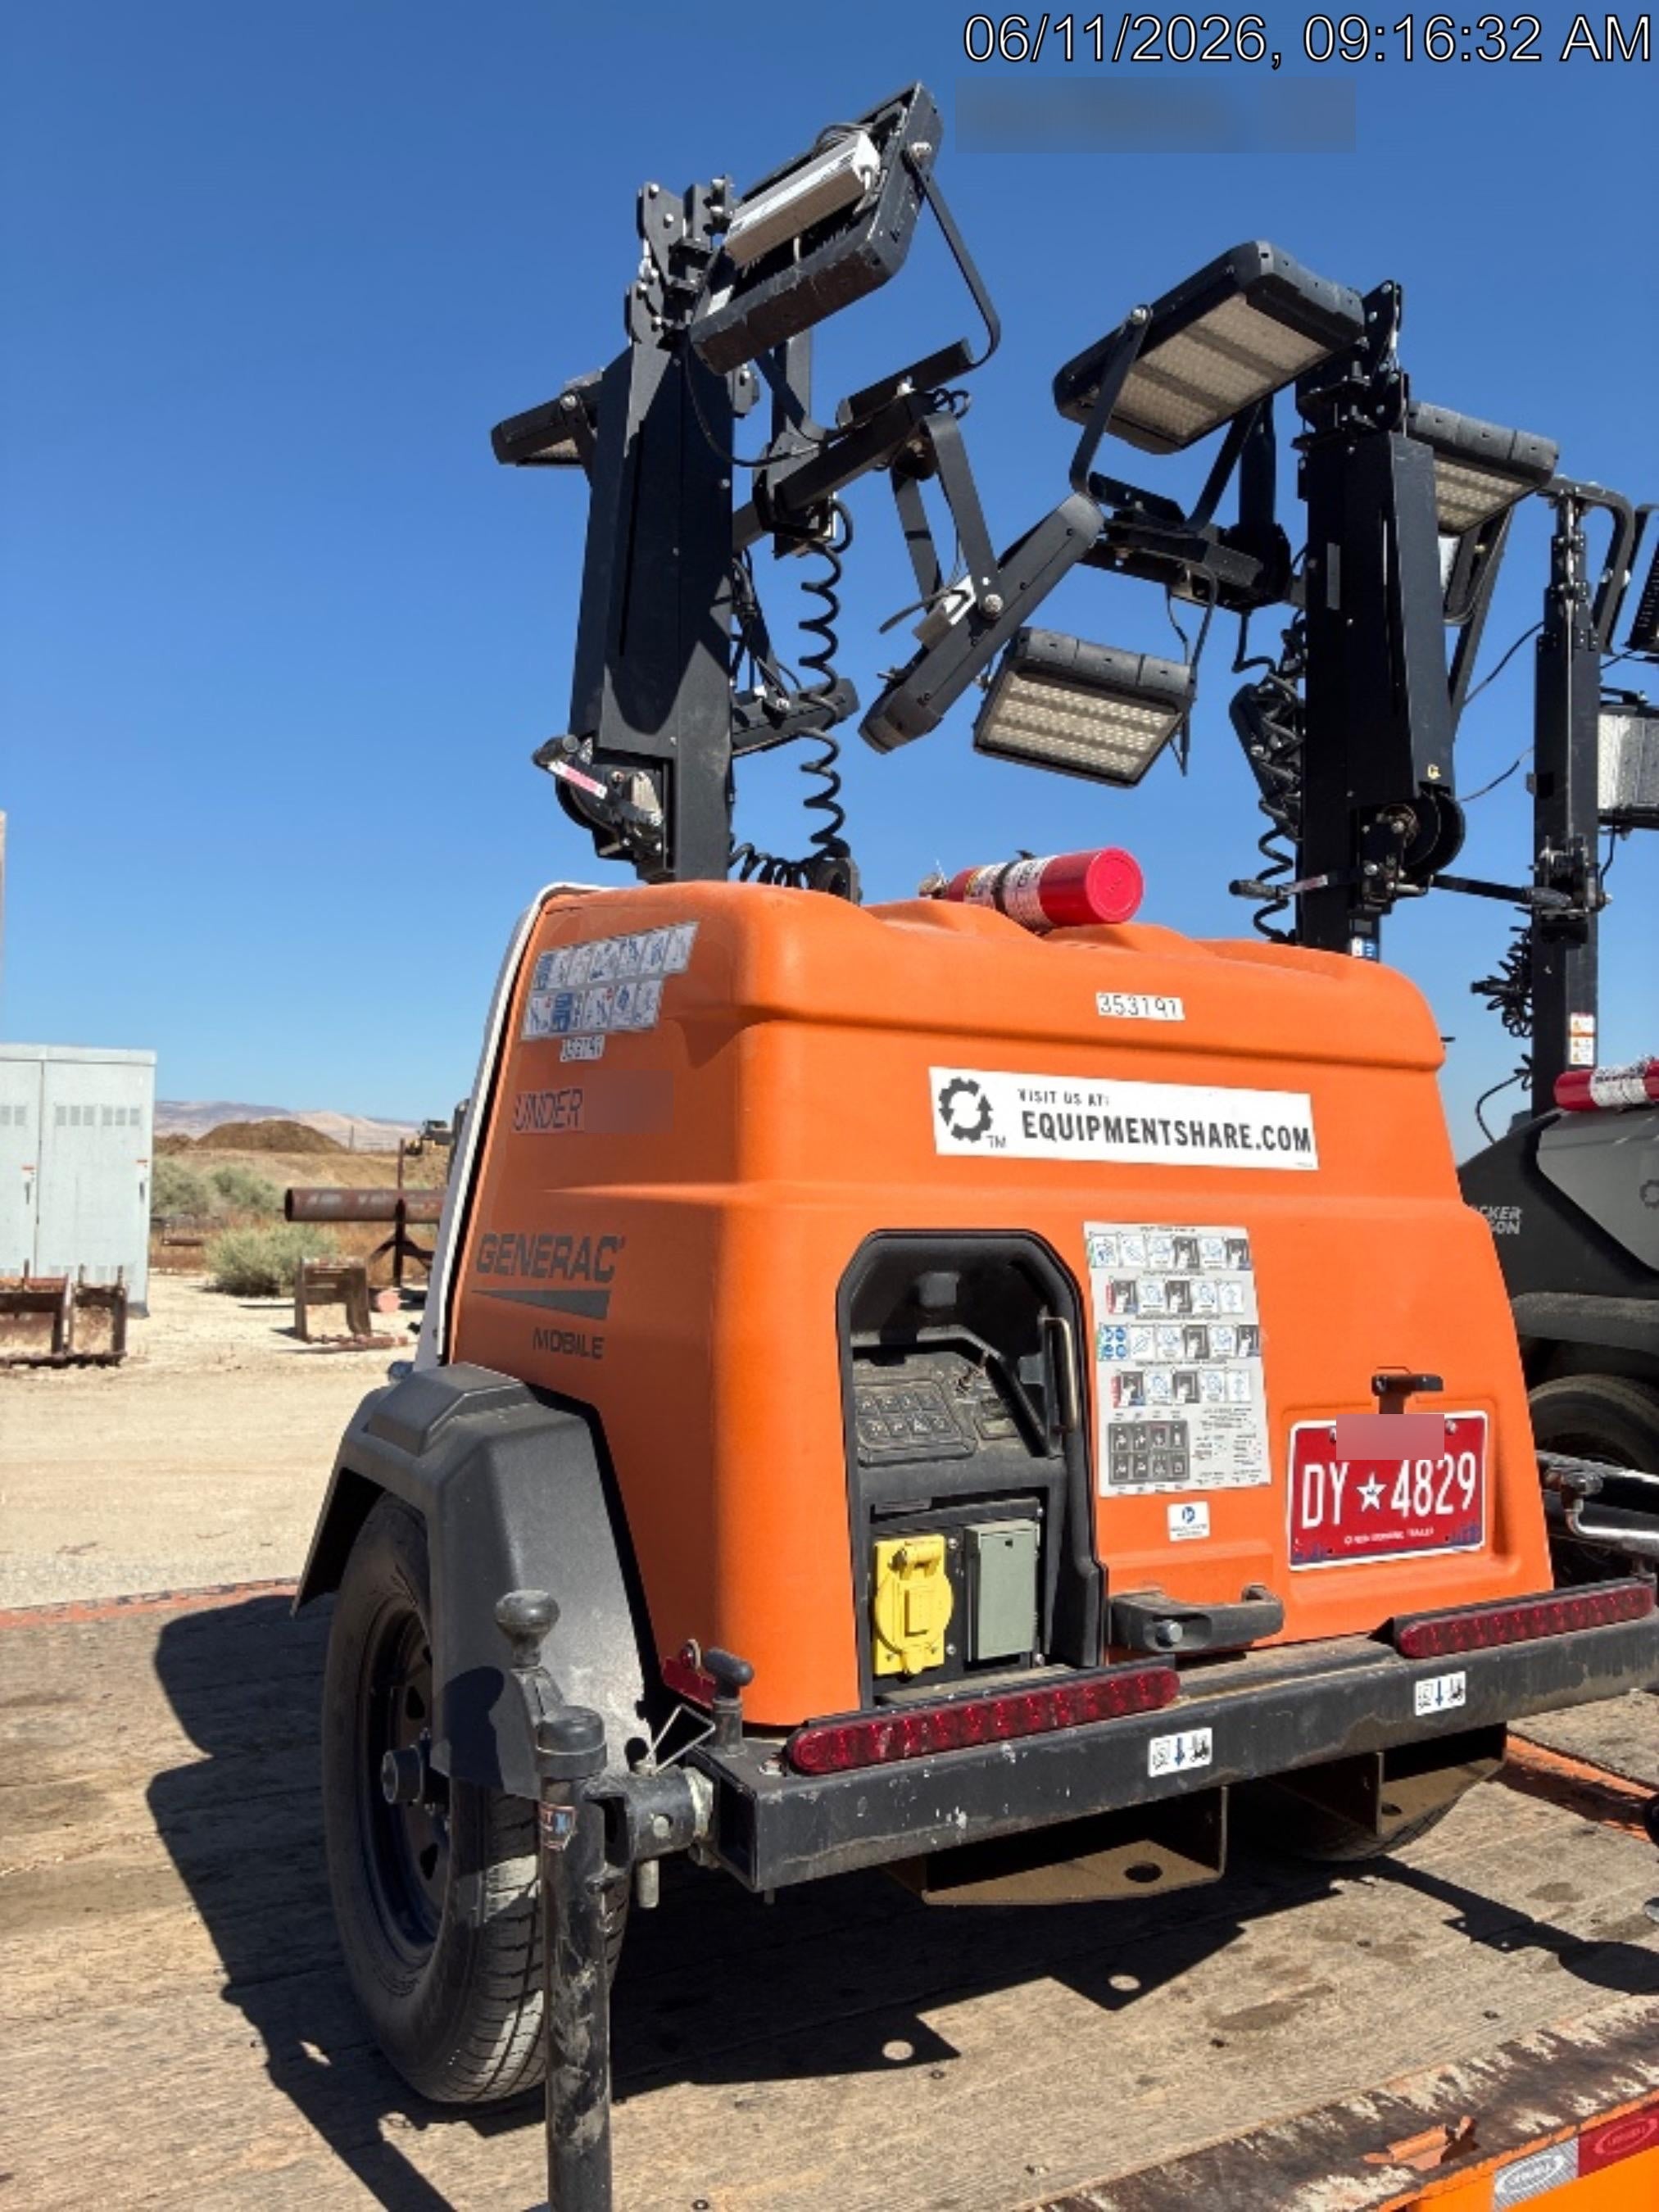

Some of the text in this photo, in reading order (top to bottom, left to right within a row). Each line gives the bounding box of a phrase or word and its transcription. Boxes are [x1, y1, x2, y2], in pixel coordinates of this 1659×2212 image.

[1018, 1088, 1056, 1104] VISIT
[1063, 1091, 1082, 1105] US
[1022, 1110, 1312, 1154] EQUIPMENTSHARE.COM
[476, 1232, 619, 1284] GENERAC
[533, 1327, 605, 1360] MOBILE
[1301, 1451, 1476, 1530] DY 4829
